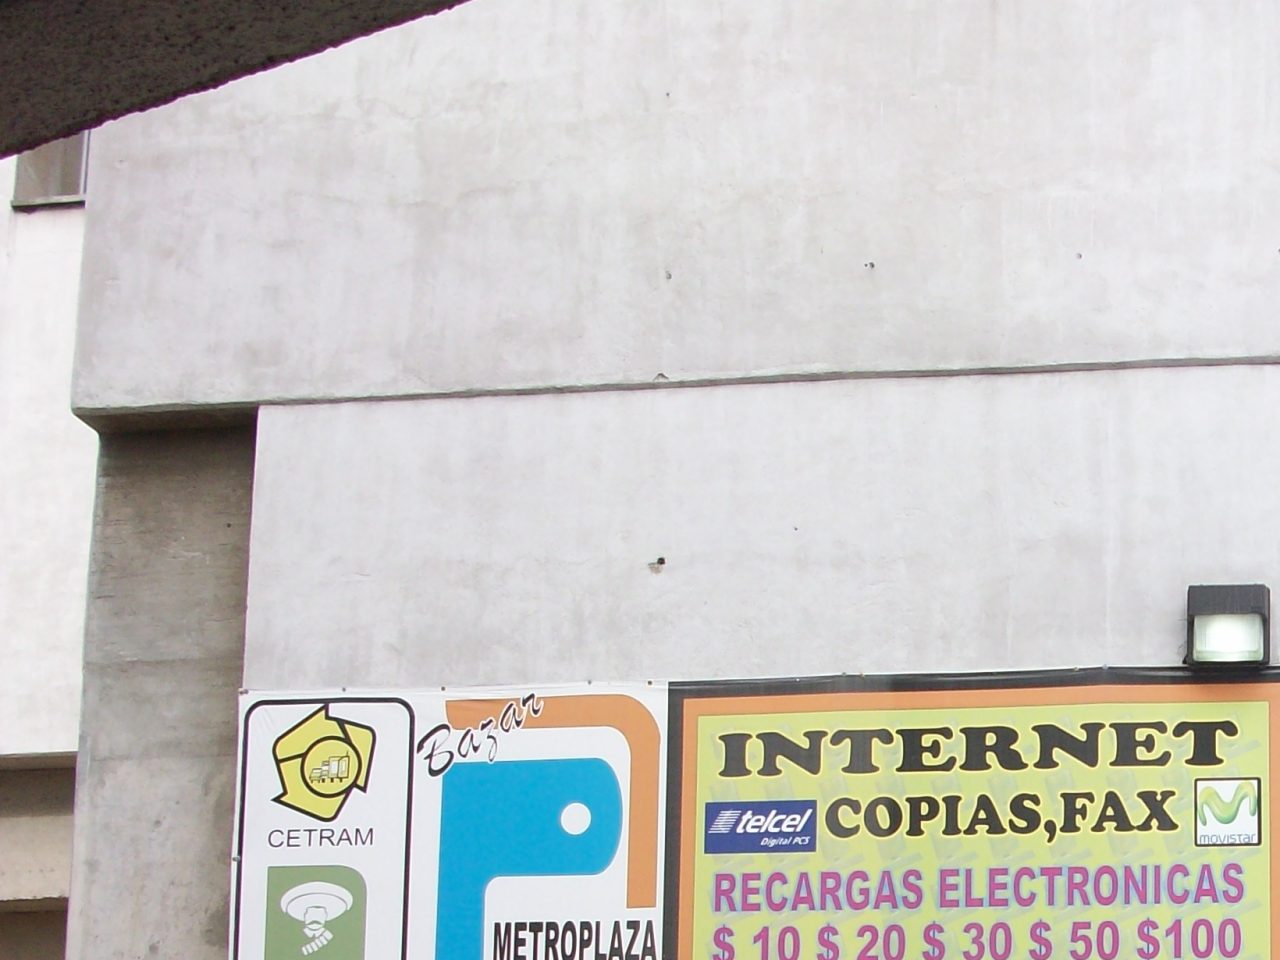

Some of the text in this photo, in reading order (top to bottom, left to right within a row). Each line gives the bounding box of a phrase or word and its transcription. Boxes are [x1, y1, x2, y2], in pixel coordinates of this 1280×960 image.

[416, 692, 544, 778] Bazar
[717, 719, 1239, 778] INTERNET
[267, 827, 375, 849] CETRAM
[735, 808, 813, 834] telcel
[760, 837, 792, 848] Digital
[824, 790, 1180, 843] COPIAS,FAX
[713, 861, 1246, 913] RECARGAS ELECTRONICAS
